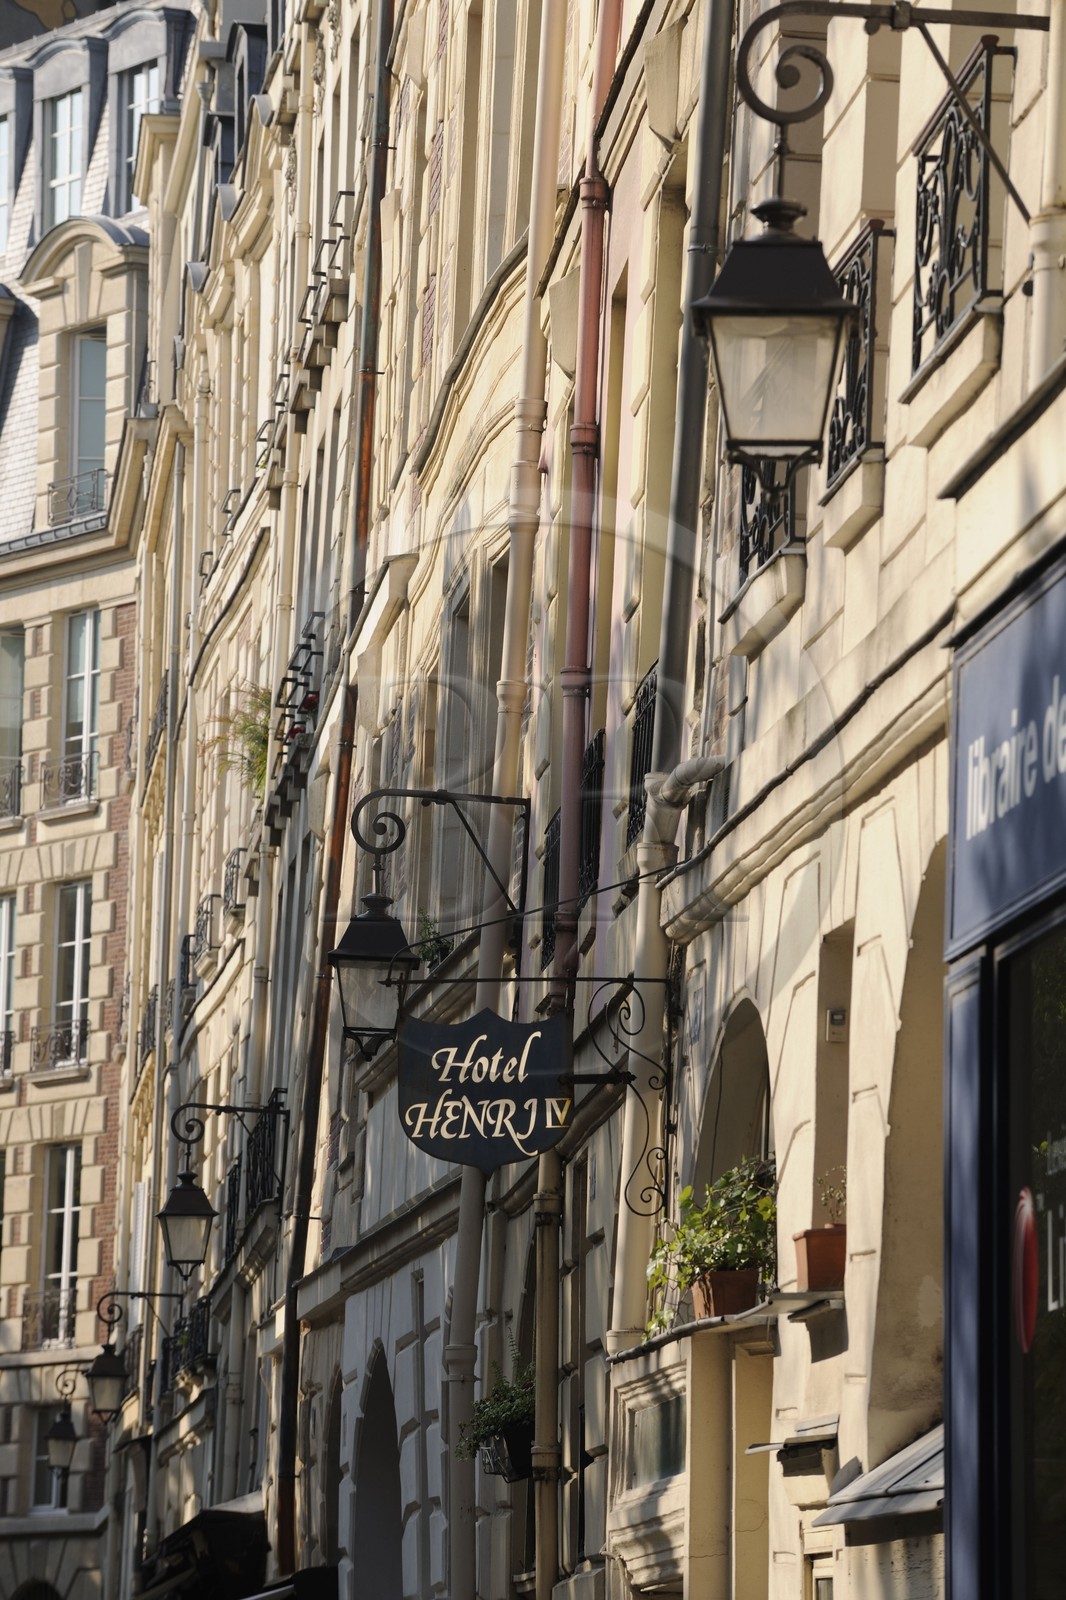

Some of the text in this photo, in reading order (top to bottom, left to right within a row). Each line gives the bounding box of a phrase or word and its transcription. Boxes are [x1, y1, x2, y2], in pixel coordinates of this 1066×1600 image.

[965, 708, 1038, 841] libraire
[431, 1031, 542, 1084] Hotel
[405, 1089, 572, 1156] HENRI IV
